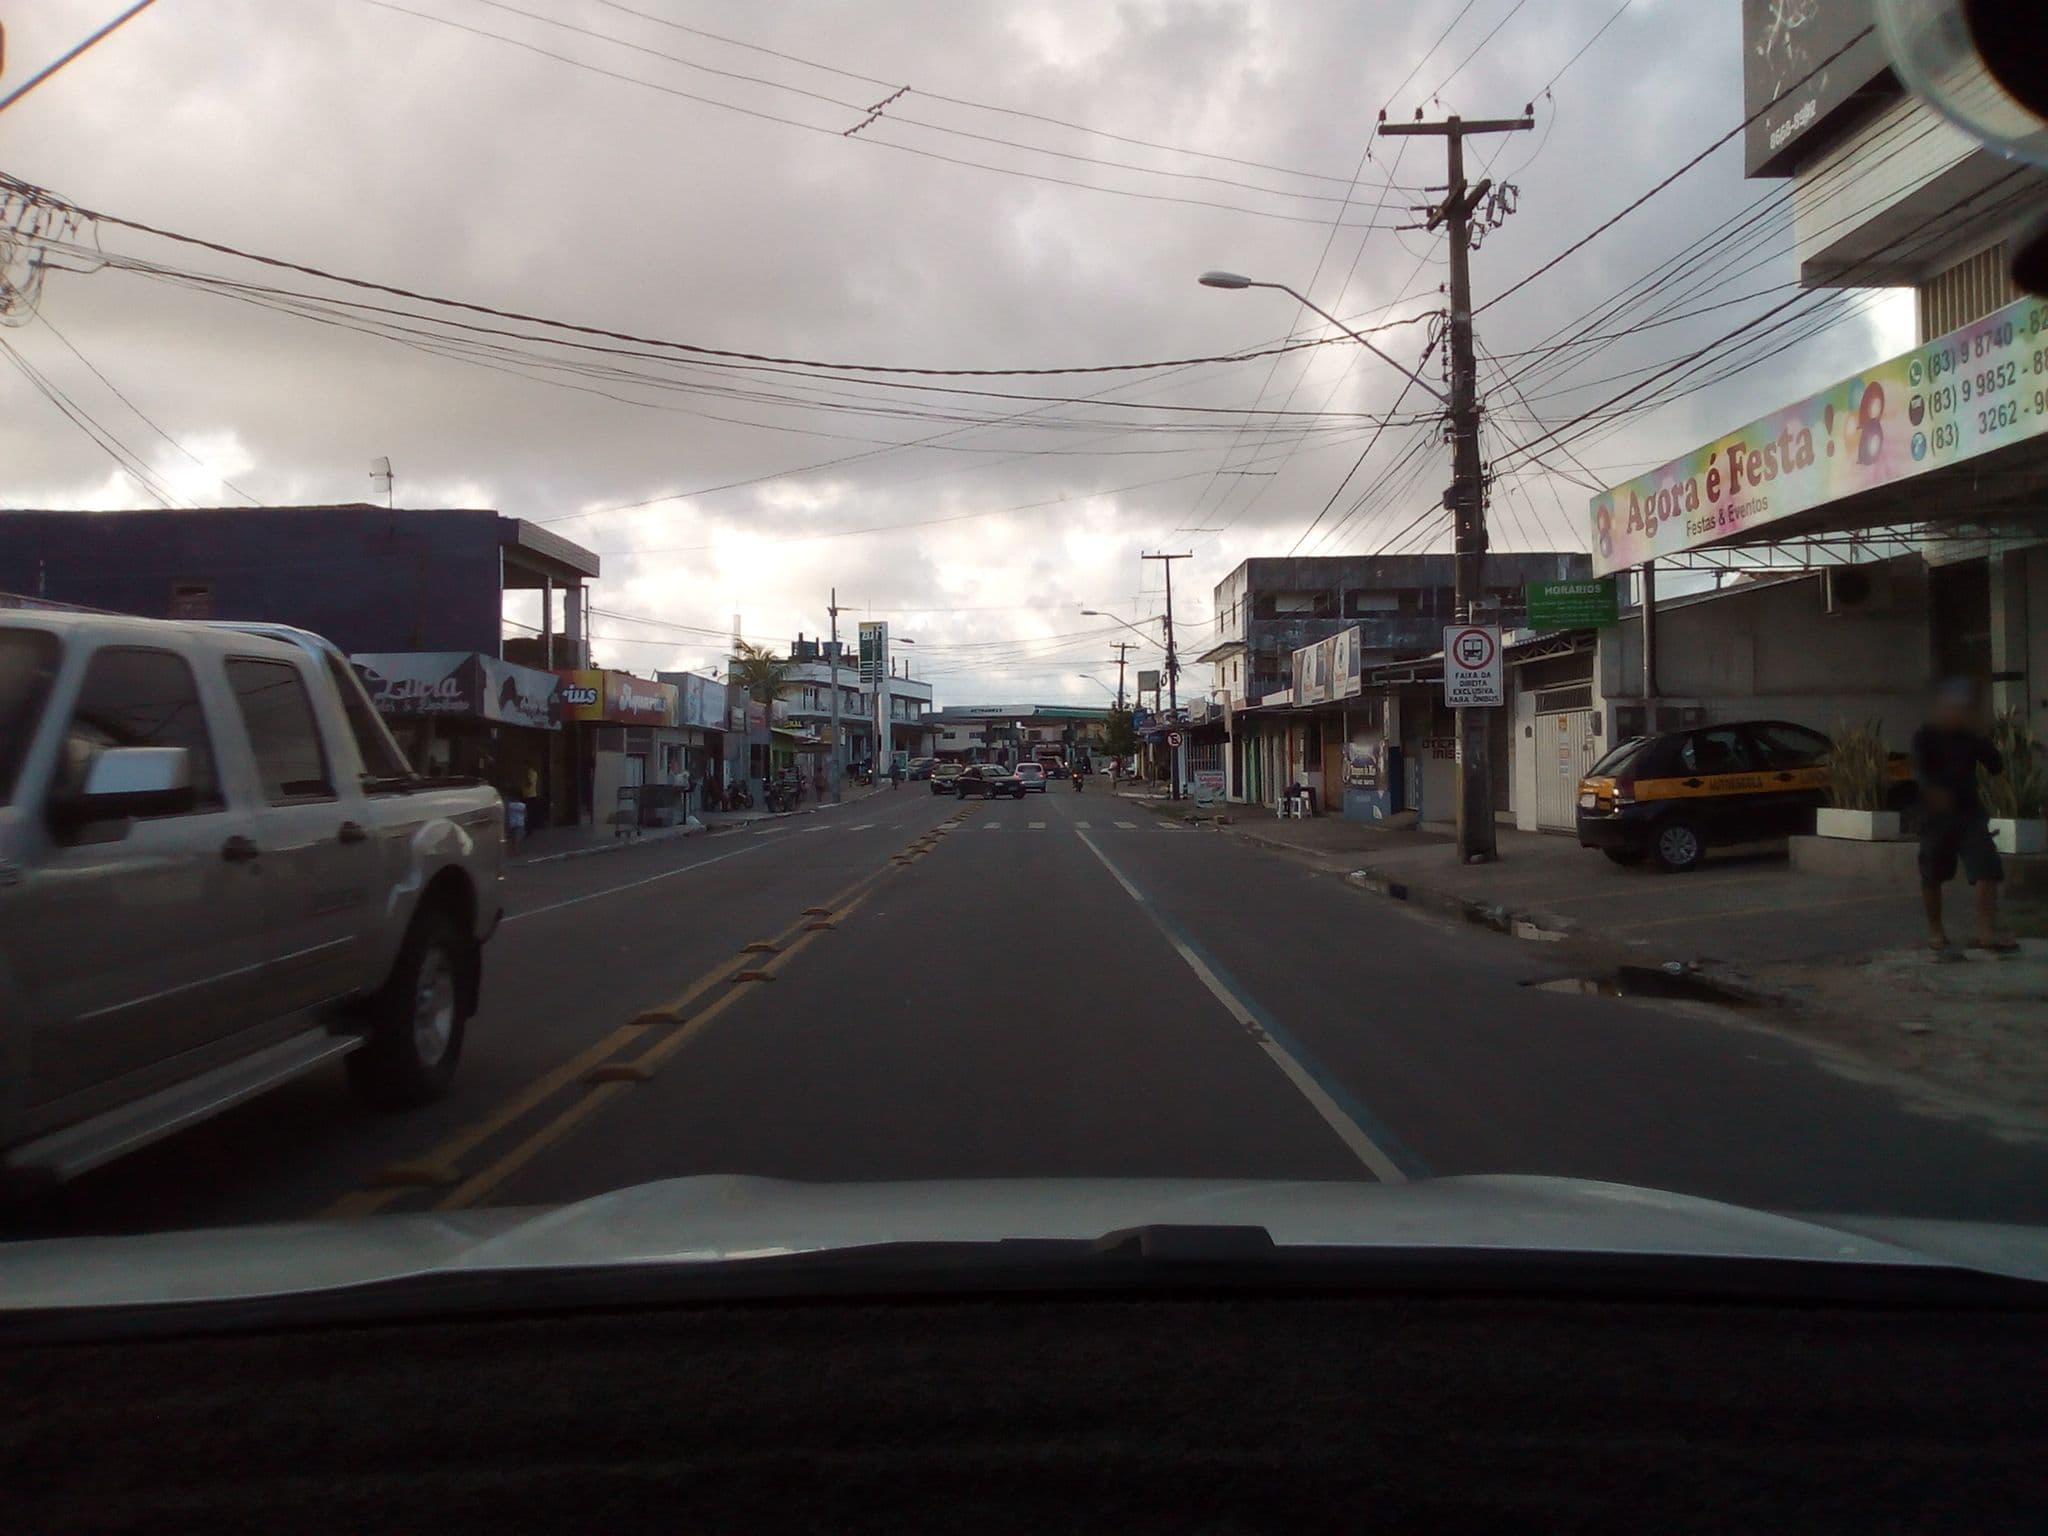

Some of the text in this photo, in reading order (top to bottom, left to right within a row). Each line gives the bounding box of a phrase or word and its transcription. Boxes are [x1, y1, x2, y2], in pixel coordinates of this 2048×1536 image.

[1928, 349, 1956, 385] (83)
[1961, 342, 1970, 364] 9
[1975, 322, 2013, 358] 8740
[1928, 385, 1958, 421] (83)
[1961, 380, 1971, 402] 9
[1976, 361, 2017, 397] 9852
[1931, 421, 1960, 457] (83)
[1978, 400, 2018, 434] 3262
[1626, 474, 1700, 539] Agora
[1706, 453, 1721, 504] é
[1727, 425, 1816, 496] Festa
[1686, 495, 1769, 537] Festas & Eventos
[1455, 671, 1478, 679] FAIXA
